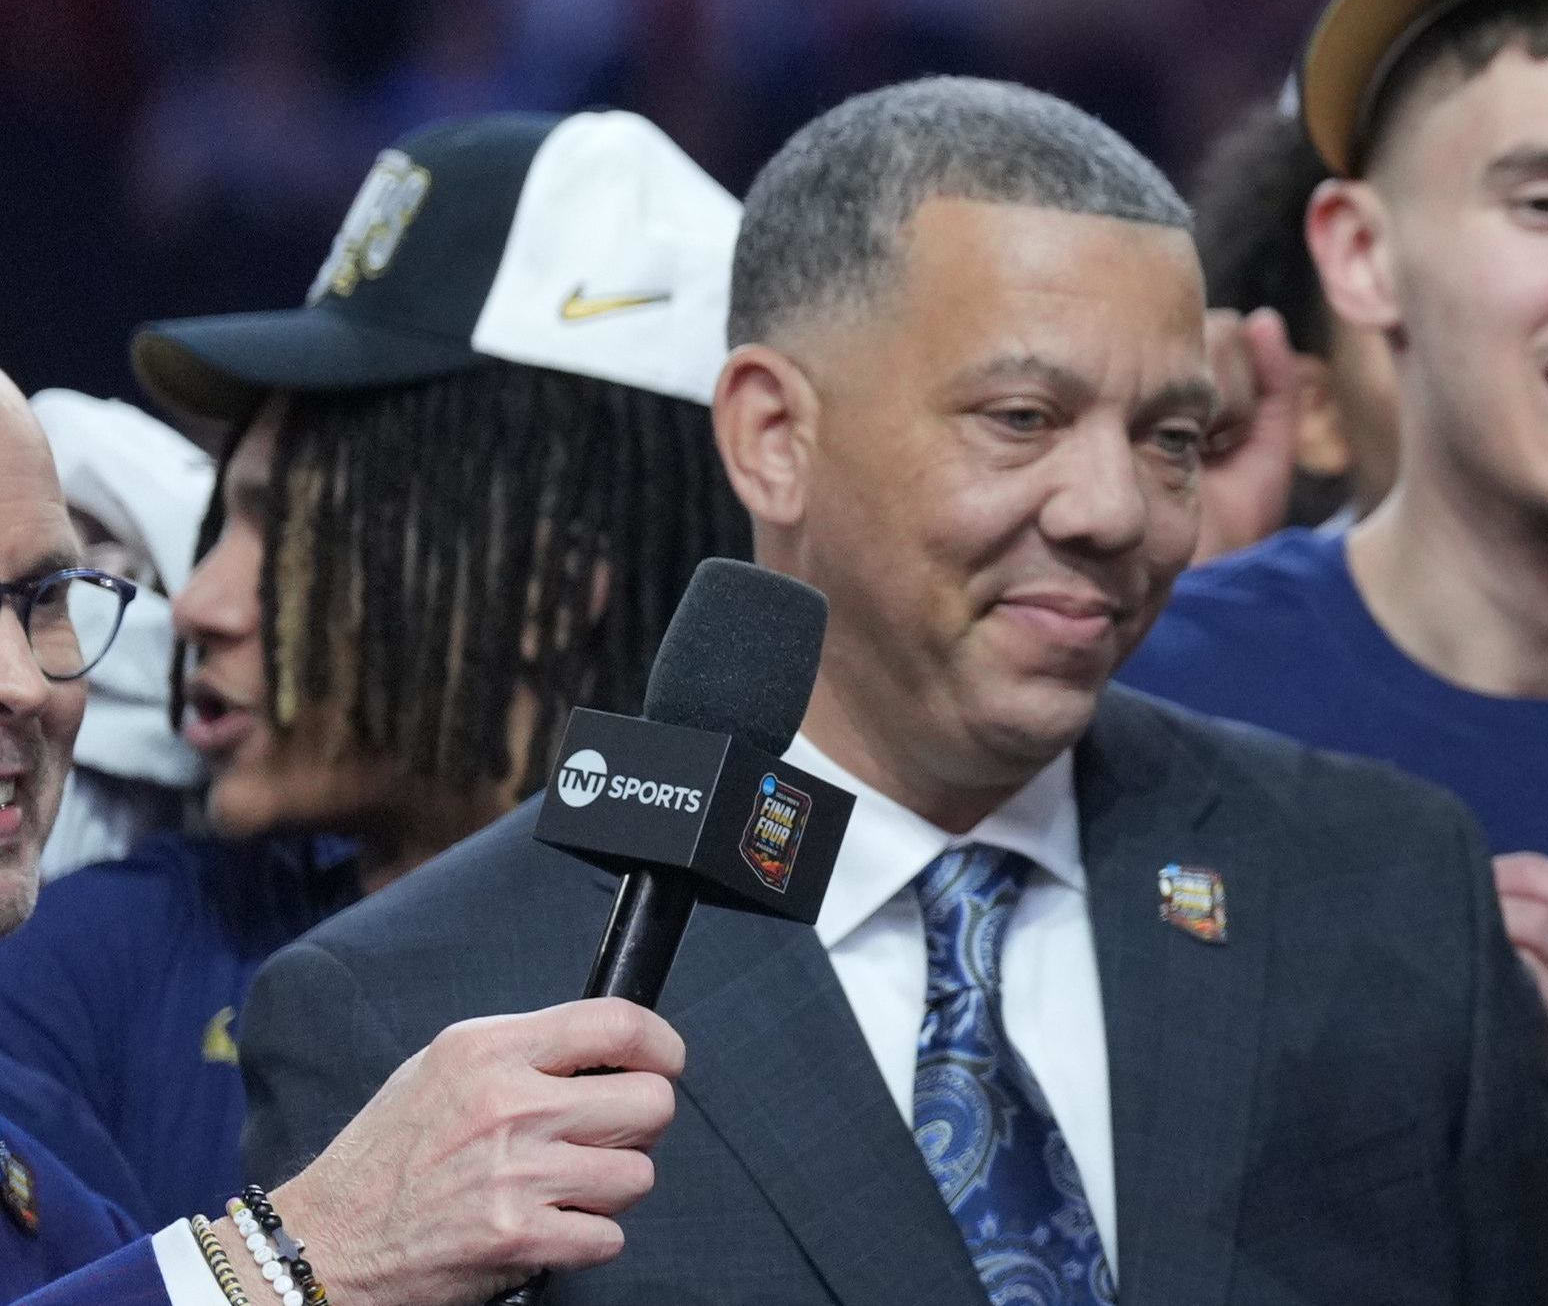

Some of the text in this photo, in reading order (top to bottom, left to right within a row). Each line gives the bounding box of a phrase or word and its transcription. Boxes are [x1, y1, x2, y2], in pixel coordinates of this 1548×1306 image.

[559, 767, 703, 813] TNT SPORTS
[760, 796, 797, 829] FINAL
[754, 815, 791, 847] FOUR
